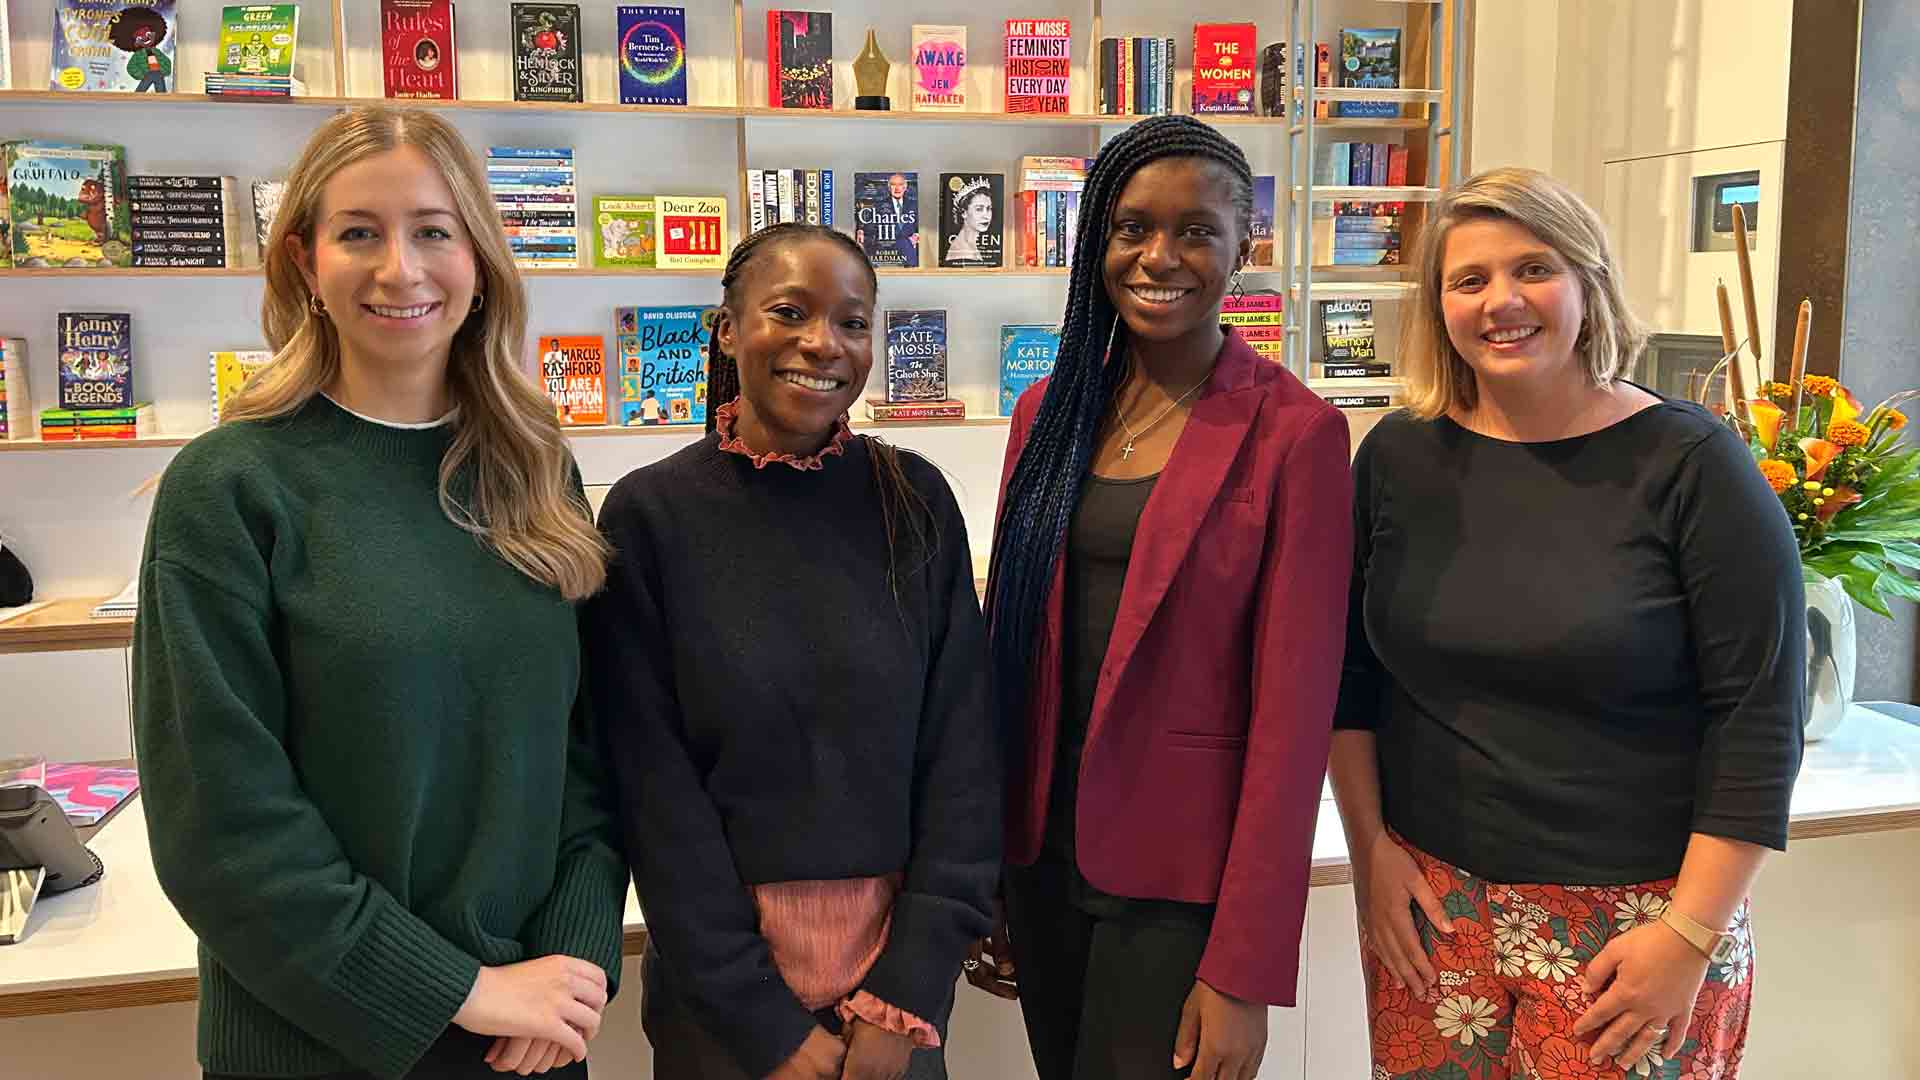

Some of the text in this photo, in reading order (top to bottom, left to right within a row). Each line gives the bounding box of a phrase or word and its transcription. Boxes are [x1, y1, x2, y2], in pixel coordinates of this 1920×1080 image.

[244, 12, 272, 22] GREEN
[386, 11, 443, 31] Rules
[1009, 22, 1067, 36] KATE MOSSE
[389, 33, 408, 50] of
[642, 34, 660, 44] Tim
[628, 43, 675, 53] Berners-Lee
[1009, 39, 1067, 57] FEMINIST
[1214, 42, 1239, 54] THE
[390, 51, 410, 66] the
[518, 55, 576, 71] HEMLOCK
[915, 50, 966, 67] AWAKE
[1009, 59, 1066, 76] HISTORY
[389, 68, 443, 88] Heart
[520, 70, 577, 86] & SILVER
[1200, 68, 1251, 81] WOMEN
[530, 86, 573, 94] KINGFISHER
[931, 80, 949, 89] JEN
[1009, 78, 1066, 94] EVERY DAY
[915, 94, 965, 104] HATMAKER
[1038, 96, 1066, 113] YEAR
[1199, 103, 1249, 112] Kristin Hannah
[13, 168, 80, 181] GRUFFALO
[823, 173, 831, 190] ROB
[807, 172, 817, 207] EDDIE
[663, 201, 720, 213] Dear Zoo
[858, 208, 916, 224] Charles
[878, 225, 896, 240] III
[1326, 302, 1370, 313] BALDACCI
[643, 312, 663, 320] DAVID
[1221, 315, 1270, 323] PETER JAMES
[65, 317, 123, 335] Lenny
[65, 331, 122, 349] Henry
[641, 323, 704, 351] Black
[900, 331, 934, 343] KATE
[1328, 337, 1372, 348] Memory
[561, 348, 601, 361] MARCUS
[657, 349, 692, 361] AND
[894, 344, 940, 356] MOSSE
[1017, 347, 1049, 358] KATE
[1350, 347, 1374, 357] Man
[543, 362, 601, 377] RASHFORD
[641, 360, 705, 389] British
[895, 369, 939, 381] Ghost Ship
[73, 382, 115, 392] BOOK
[544, 378, 602, 391] YOU ARE A
[64, 393, 123, 403] LEGENDS
[894, 409, 910, 417] KATE
